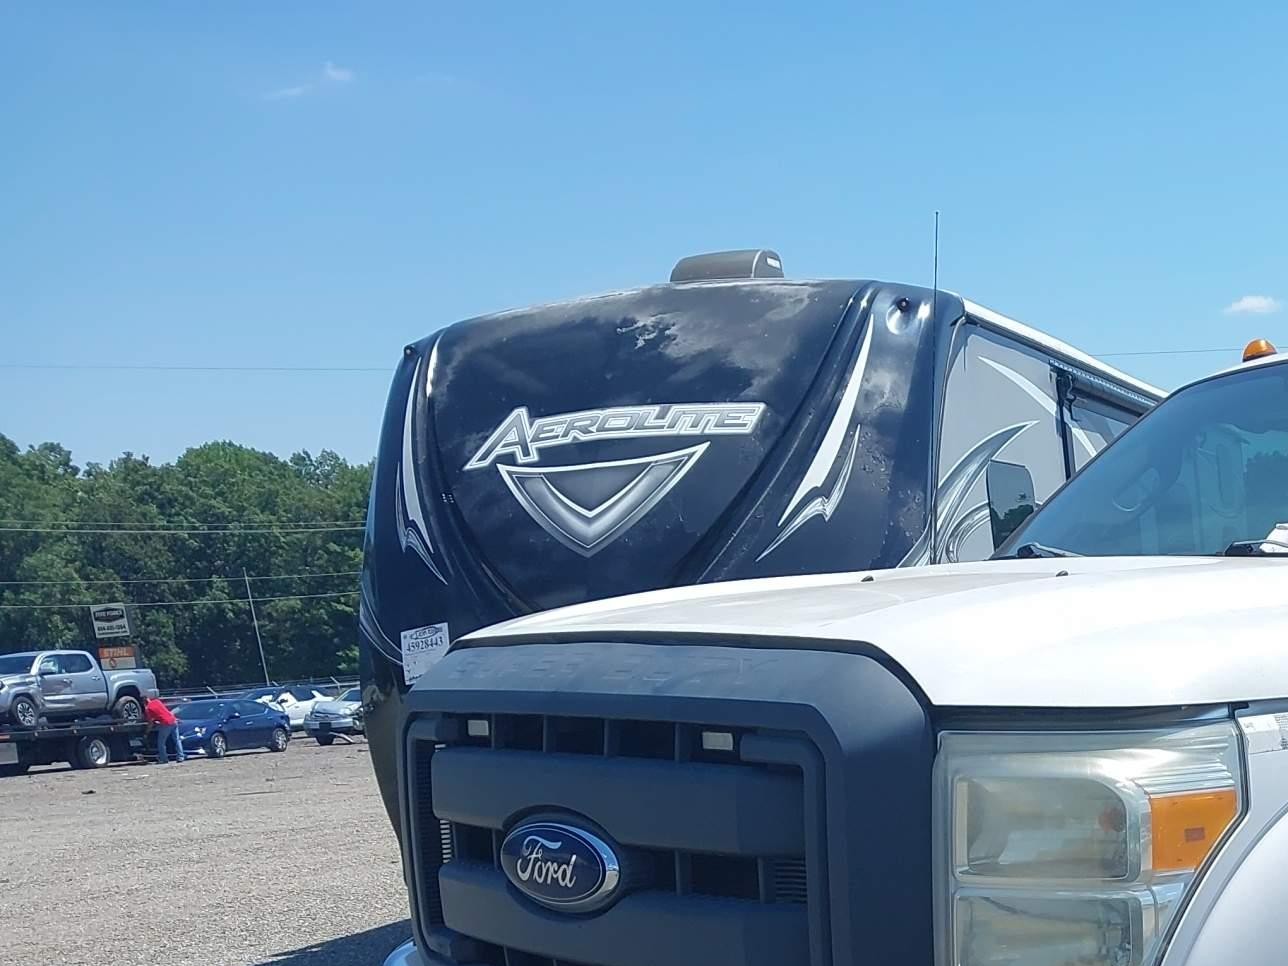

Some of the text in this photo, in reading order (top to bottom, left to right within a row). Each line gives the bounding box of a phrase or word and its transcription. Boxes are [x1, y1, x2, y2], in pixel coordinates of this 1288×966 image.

[463, 402, 767, 471] AEROLITE
[406, 635, 444, 652] 45928443
[516, 835, 577, 888] Ford
